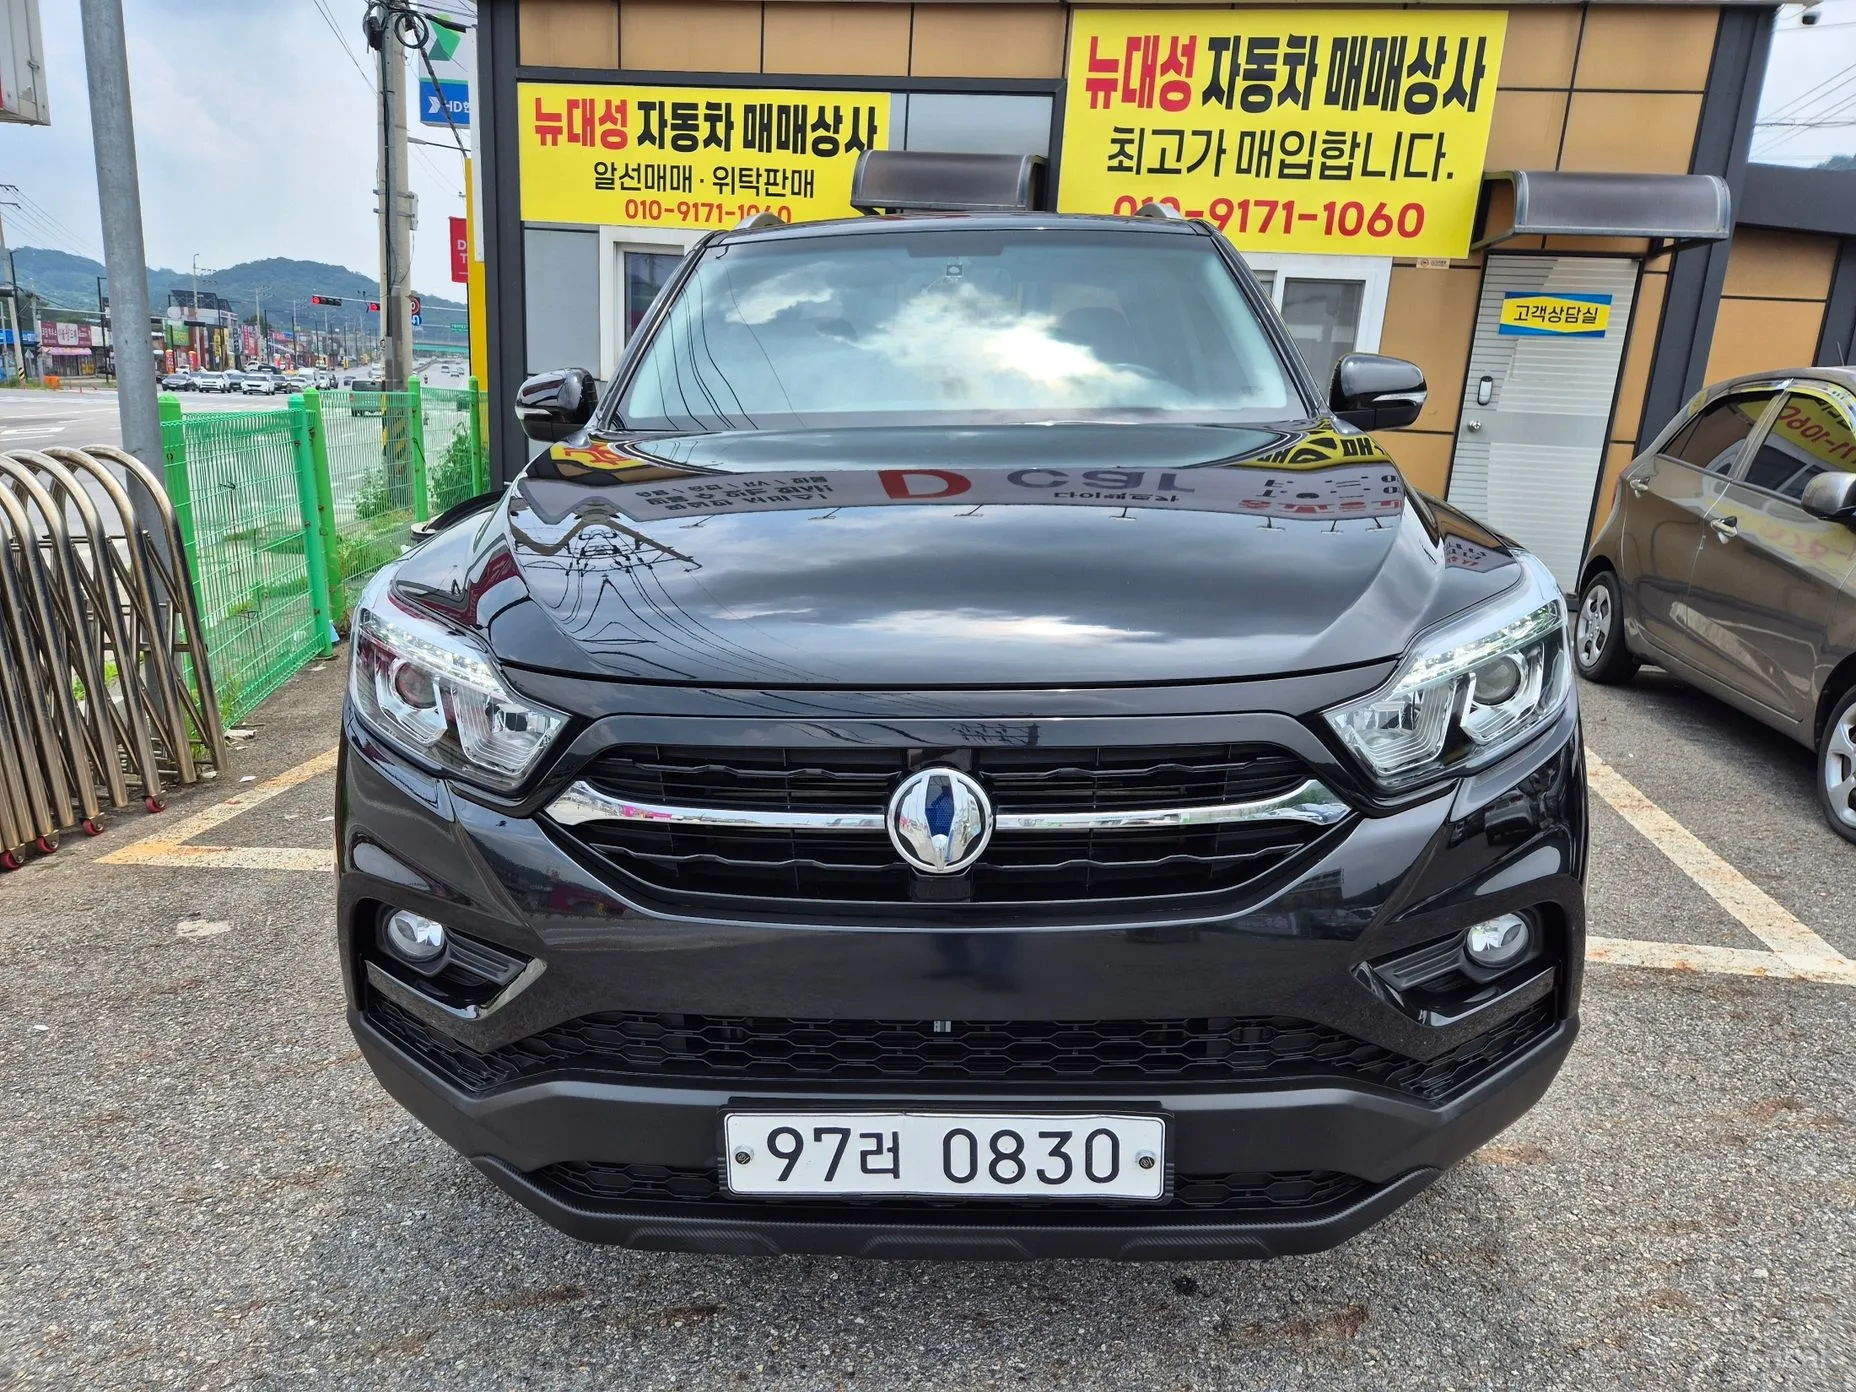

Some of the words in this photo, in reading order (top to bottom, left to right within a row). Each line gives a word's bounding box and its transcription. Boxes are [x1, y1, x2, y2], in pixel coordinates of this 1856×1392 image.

[1085, 35, 1197, 112] 뉴대성
[1202, 33, 1319, 114] 자동차
[1323, 35, 1488, 115] 매매상사
[534, 97, 628, 150] 뉴대성
[637, 100, 735, 153] 자동차
[742, 103, 878, 158] 매매상사
[1107, 126, 1227, 177] 최고가
[1235, 129, 1454, 182] 매입합니다.
[594, 161, 692, 193] 알선매매
[712, 166, 815, 198] 위탁판매
[1113, 195, 1425, 238] 0-9171-1060
[1513, 304, 1599, 324] 고객상담실
[767, 1127, 900, 1182] 97러
[943, 1128, 1120, 1185] 0830
